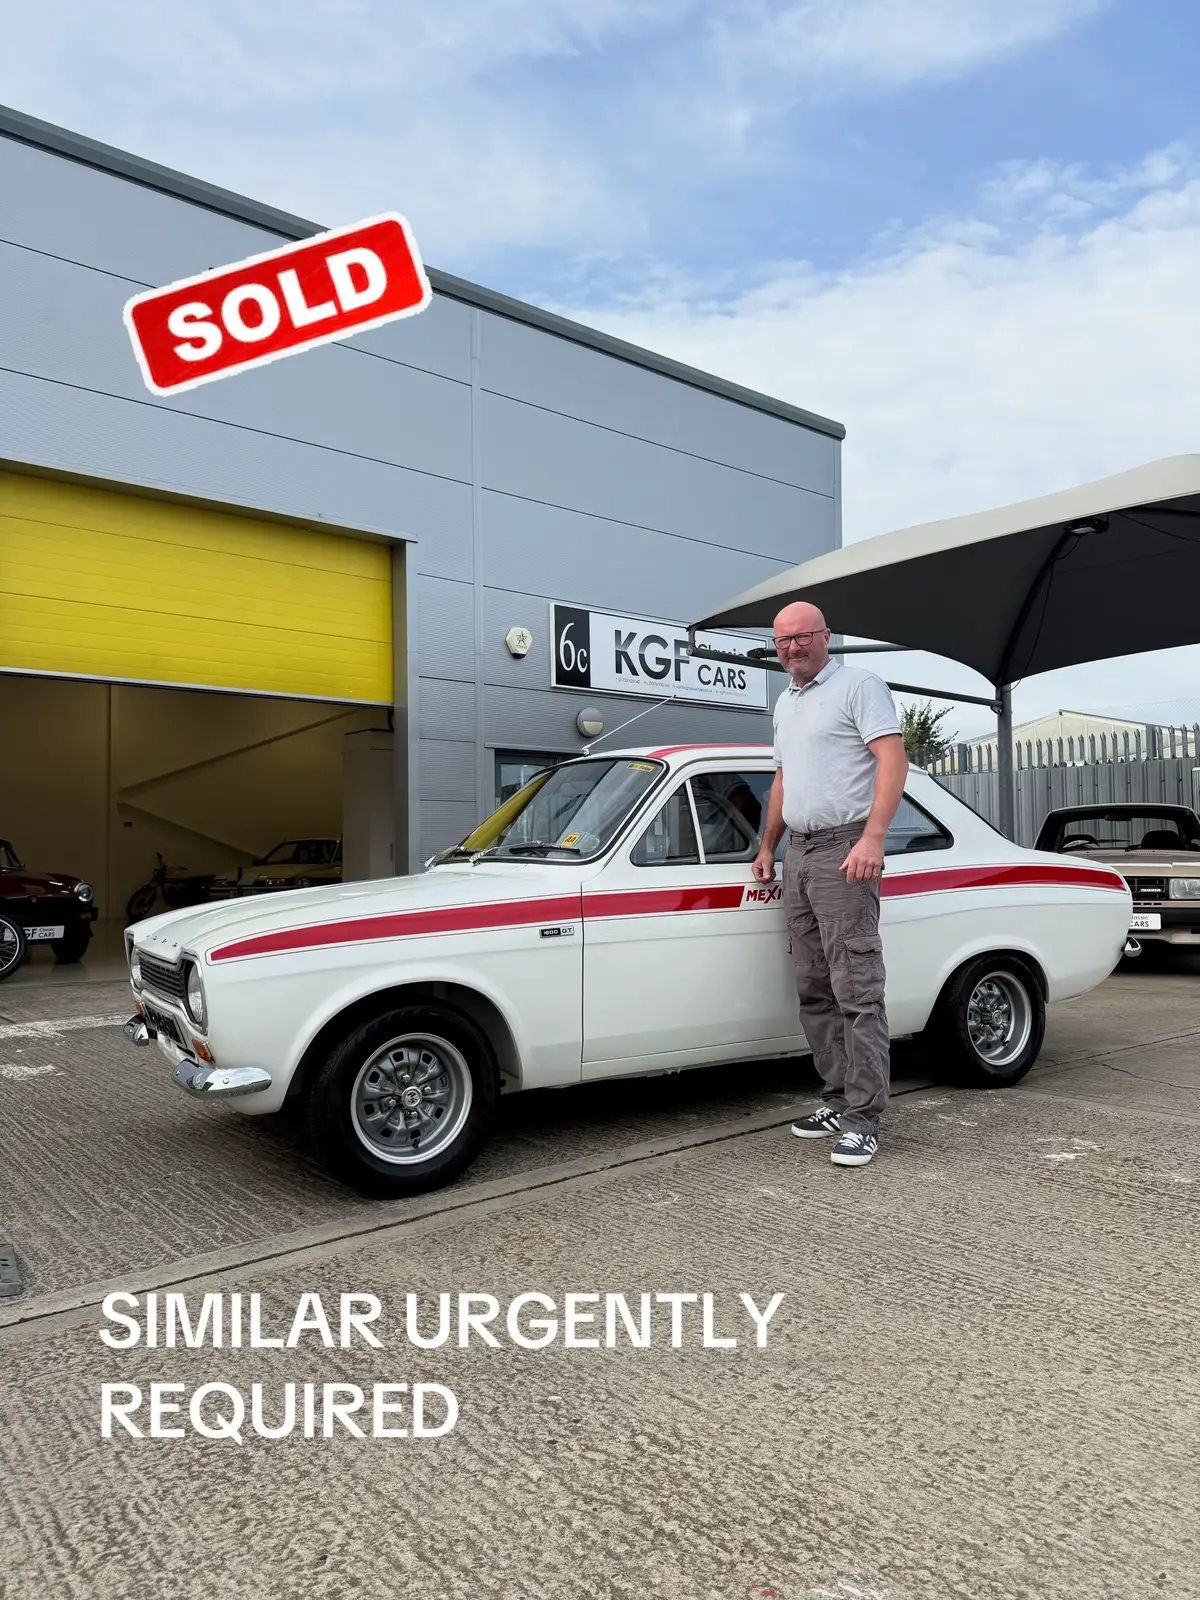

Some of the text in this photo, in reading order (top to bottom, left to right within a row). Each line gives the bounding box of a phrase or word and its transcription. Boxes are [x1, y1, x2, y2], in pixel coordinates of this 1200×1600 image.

[560, 622, 588, 673] 6c
[614, 629, 690, 682] KGF
[697, 664, 747, 690] CARS
[746, 885, 784, 904] MEXI
[23, 928, 38, 939] GF
